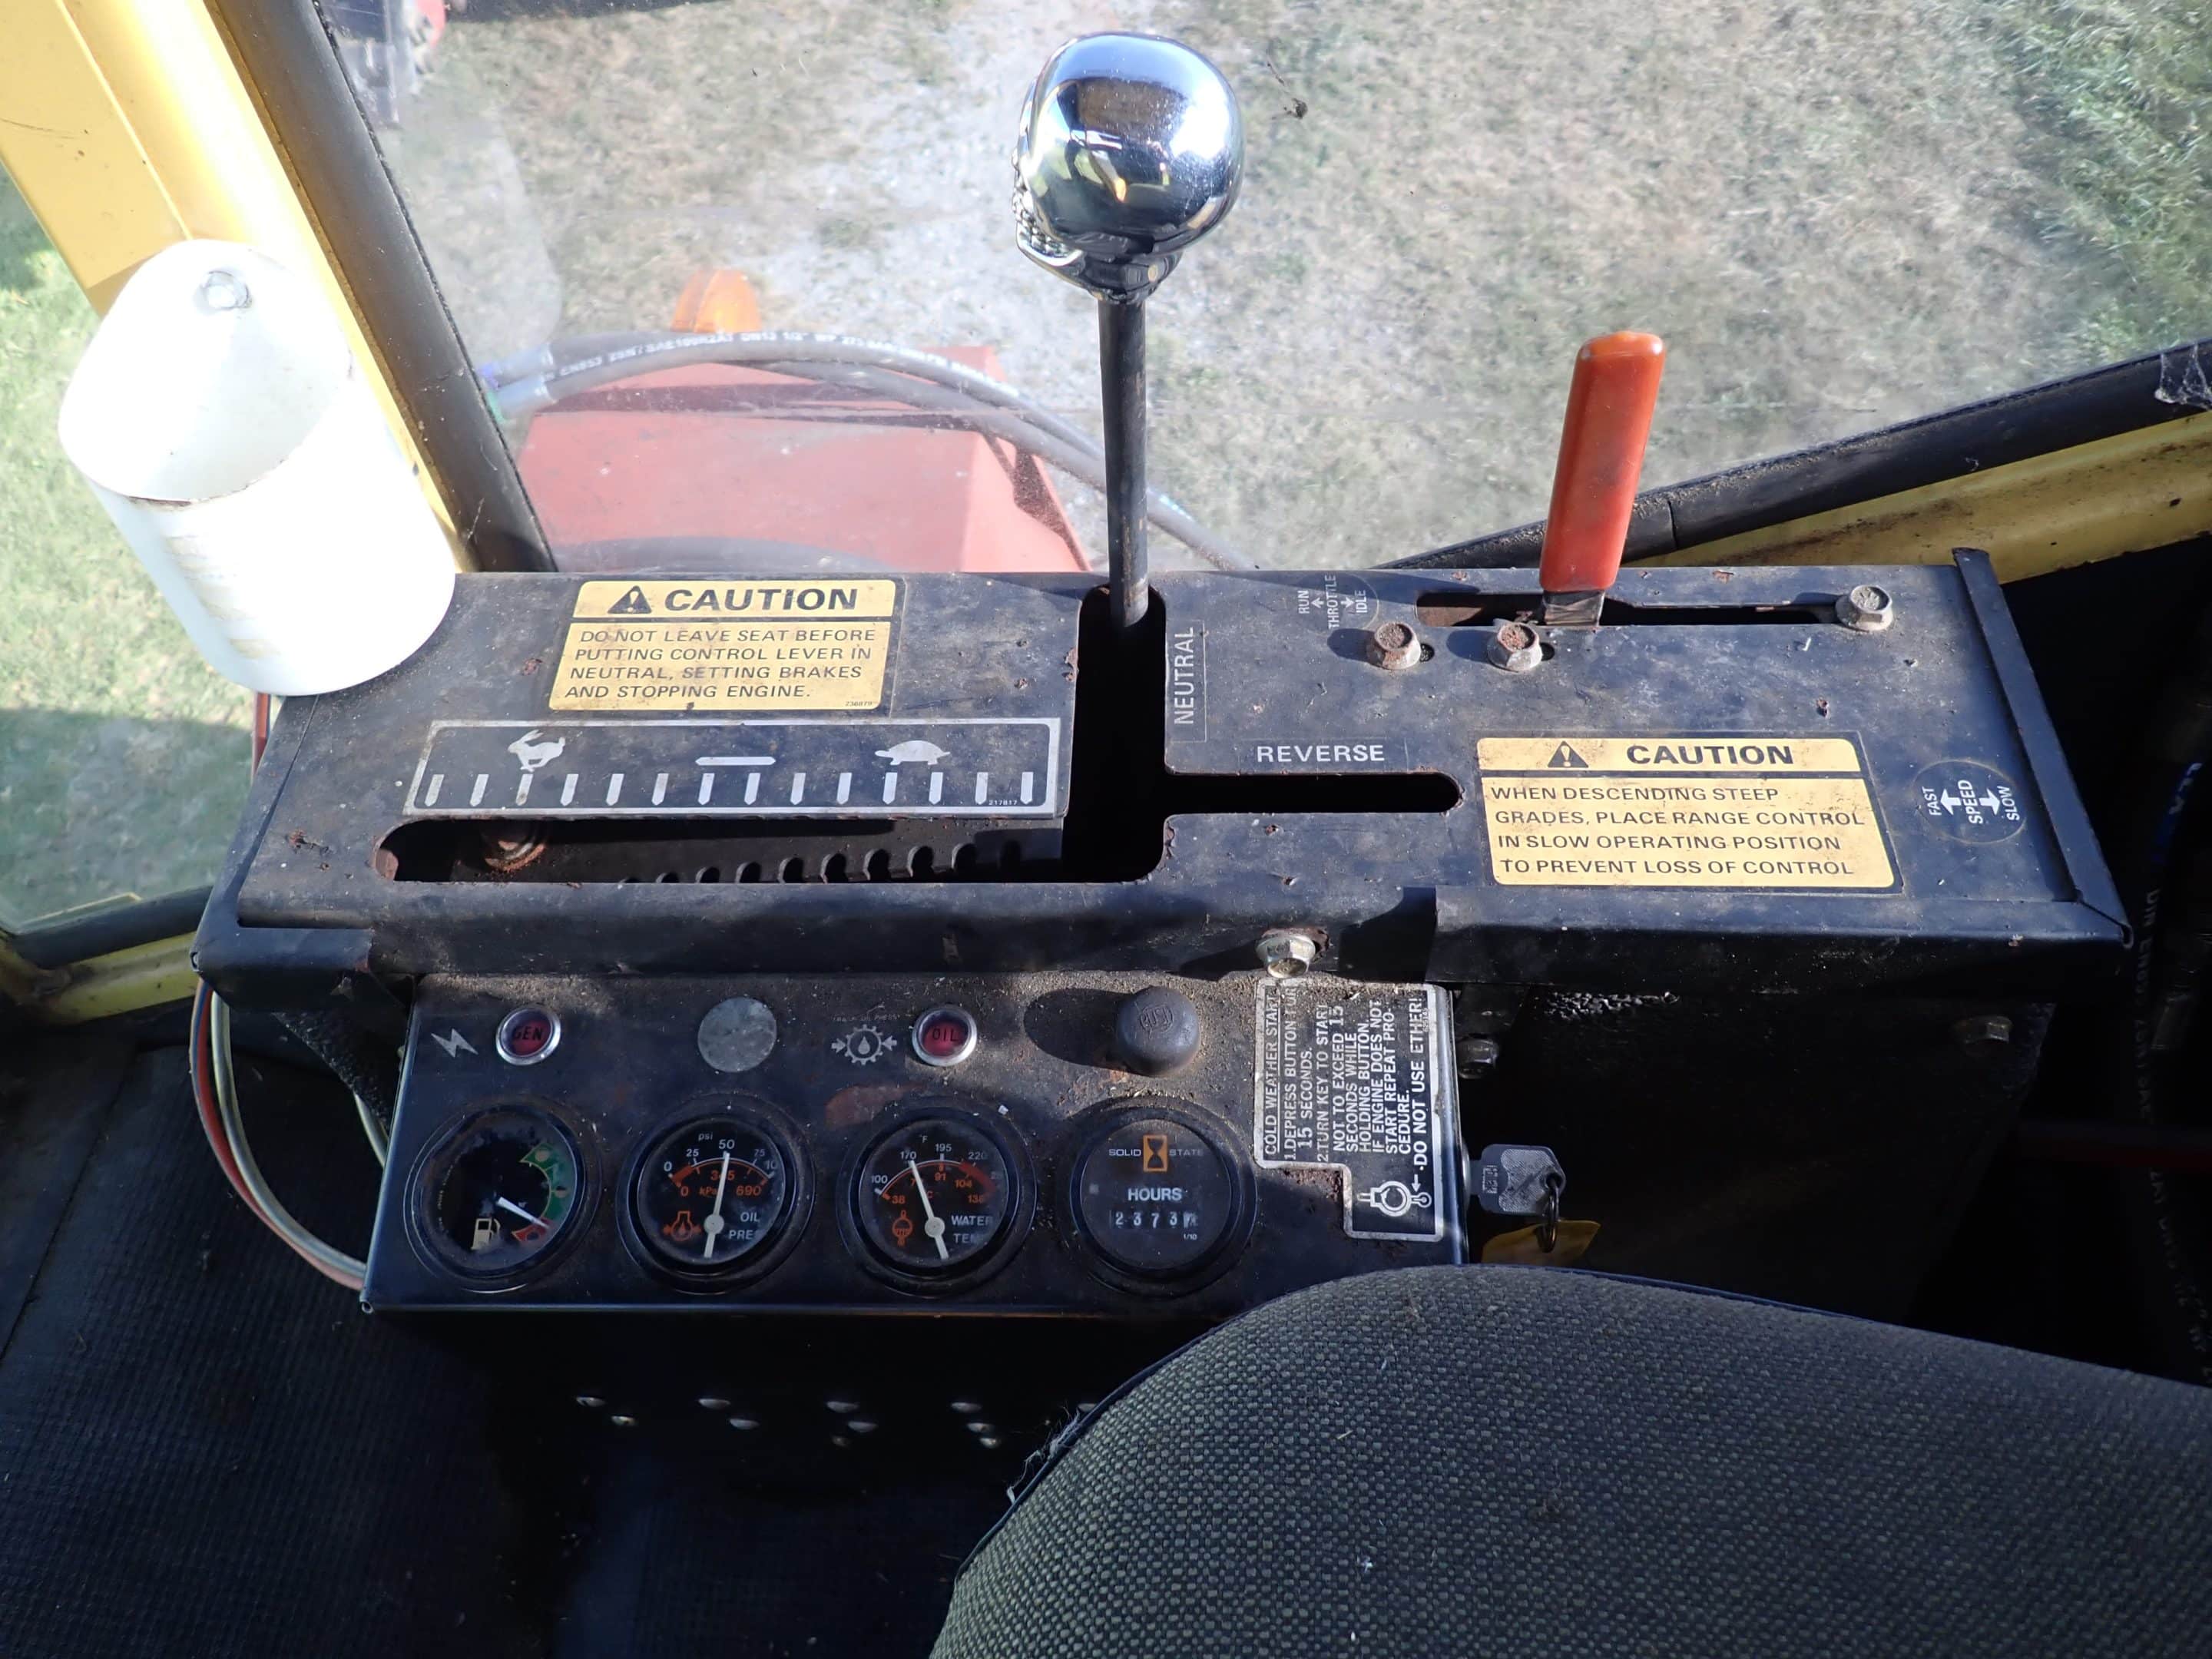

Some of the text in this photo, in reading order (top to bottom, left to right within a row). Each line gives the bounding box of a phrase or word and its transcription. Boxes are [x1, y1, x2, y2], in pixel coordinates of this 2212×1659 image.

[664, 588, 858, 612] CAUTION
[1297, 590, 1310, 614] RUN
[1324, 575, 1340, 630] THROTTLE
[1354, 589, 1368, 613] IDLE
[580, 629, 876, 643] DO NOT LEAVE SEAT BEFORE
[574, 647, 872, 661] PUTTING CONTROL LEVER IN
[569, 666, 863, 680] NEUTRAL, SETTING BRAKES
[1174, 627, 1194, 725] NEUTRAL
[565, 685, 810, 698] AND STOPPING ENGINE.
[1256, 744, 1386, 763] REVERSE
[1626, 744, 1794, 765] CAUTION
[1491, 786, 1779, 800] WHEN DESCENDING STEEP
[1922, 786, 1942, 816] FAST
[1957, 780, 1984, 824] SPEED
[1996, 786, 2020, 821] SLOW
[1495, 810, 1865, 826] GRADES, PLACE RANGE CONTROL
[1498, 835, 1840, 850] IN SLOW OPERATING POSITION
[1501, 859, 1854, 875] TO PREVENT LOSS OF CONTROL
[1316, 1003, 1329, 1045] START
[1409, 997, 1424, 1054] ETHER!
[932, 1028, 959, 1042] OIL
[1284, 1020, 1297, 1077] BUTTON
[1316, 1050, 1329, 1070] TO
[1265, 1041, 1278, 1108] WEATHER
[1329, 1005, 1346, 1152] NOT TO EXCEED 15
[1369, 999, 1385, 1152] IF ENGINE DOES NOT
[1382, 1007, 1398, 1154] START REPEAT PRO-
[1411, 1061, 1426, 1093] USE
[1316, 1075, 1329, 1104] KEY
[1344, 1032, 1358, 1152] SECONDS WHILE
[1357, 1019, 1372, 1152] HOLDING BUTTON.
[1297, 1046, 1313, 1149] 15 SECONDS.
[1397, 1089, 1411, 1155] CEDURE.
[1412, 1099, 1427, 1134] NOT
[698, 1132, 714, 1141] psi
[718, 1139, 735, 1150] 50
[1265, 1115, 1277, 1155] COLD
[686, 1149, 700, 1157] 25
[900, 1151, 918, 1161] 170
[935, 1144, 952, 1152] 195
[1108, 1148, 1204, 1157] SOLID STATE
[663, 1161, 673, 1172] 0
[710, 1171, 735, 1181] 35
[871, 1175, 889, 1184] 100
[934, 1173, 946, 1181] 91
[955, 1179, 973, 1189] 104
[680, 1187, 689, 1197] 0
[735, 1185, 762, 1197] 690
[892, 1195, 906, 1205] 38
[1128, 1187, 1183, 1202] HOURS
[740, 1212, 760, 1224] OIL
[951, 1214, 994, 1226] WATER
